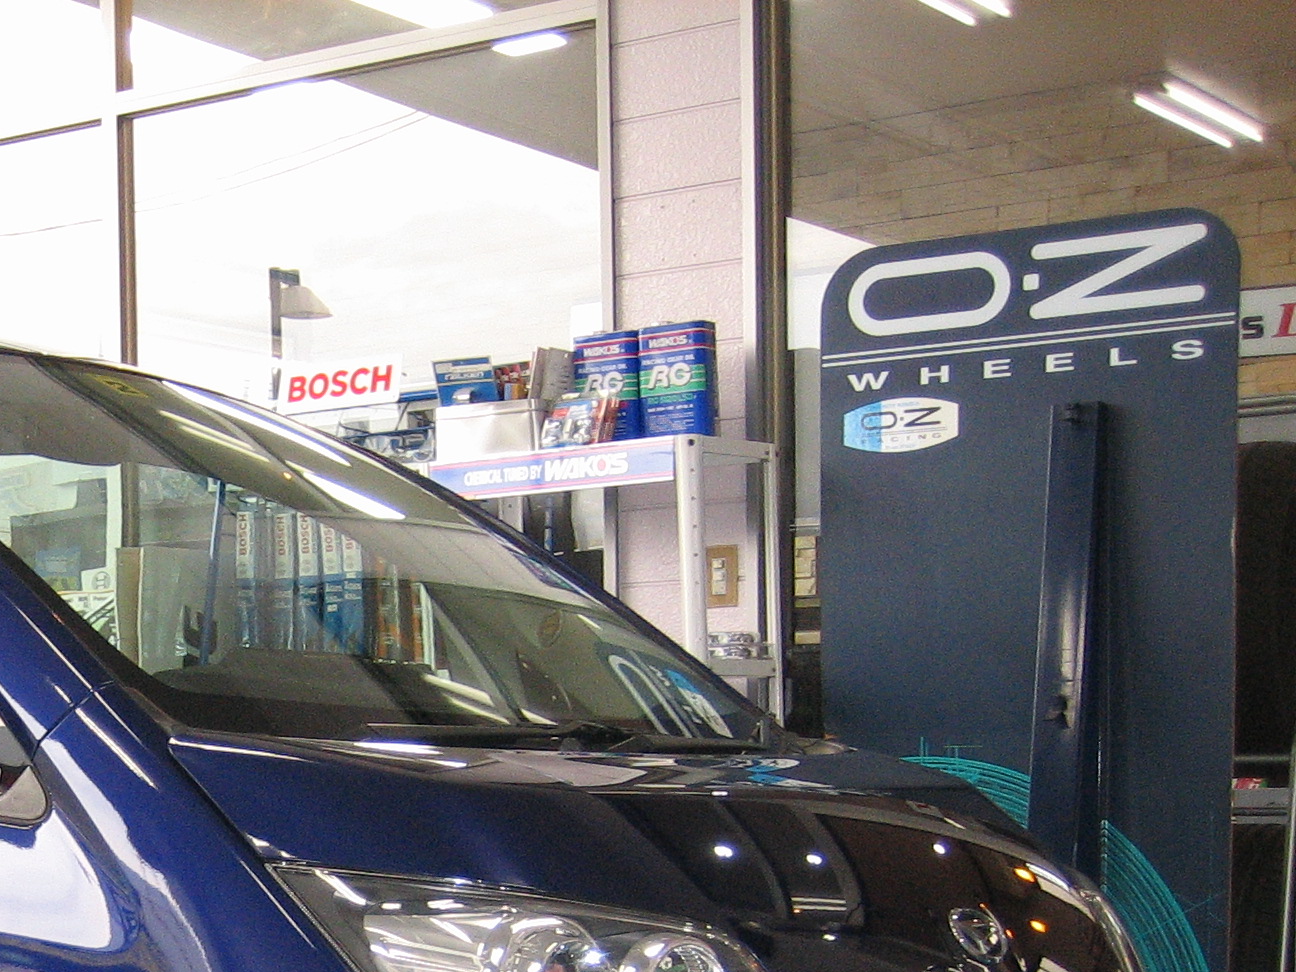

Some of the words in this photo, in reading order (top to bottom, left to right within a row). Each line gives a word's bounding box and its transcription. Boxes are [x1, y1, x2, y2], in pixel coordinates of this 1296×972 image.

[288, 365, 393, 402] BOSCH
[582, 371, 624, 395] RG
[648, 362, 692, 390] RG
[847, 340, 1204, 392] WHEELS
[529, 464, 542, 481] BY
[239, 514, 247, 556] BOSCH
[278, 516, 286, 556] BOSCH
[301, 514, 310, 554] BOSCH
